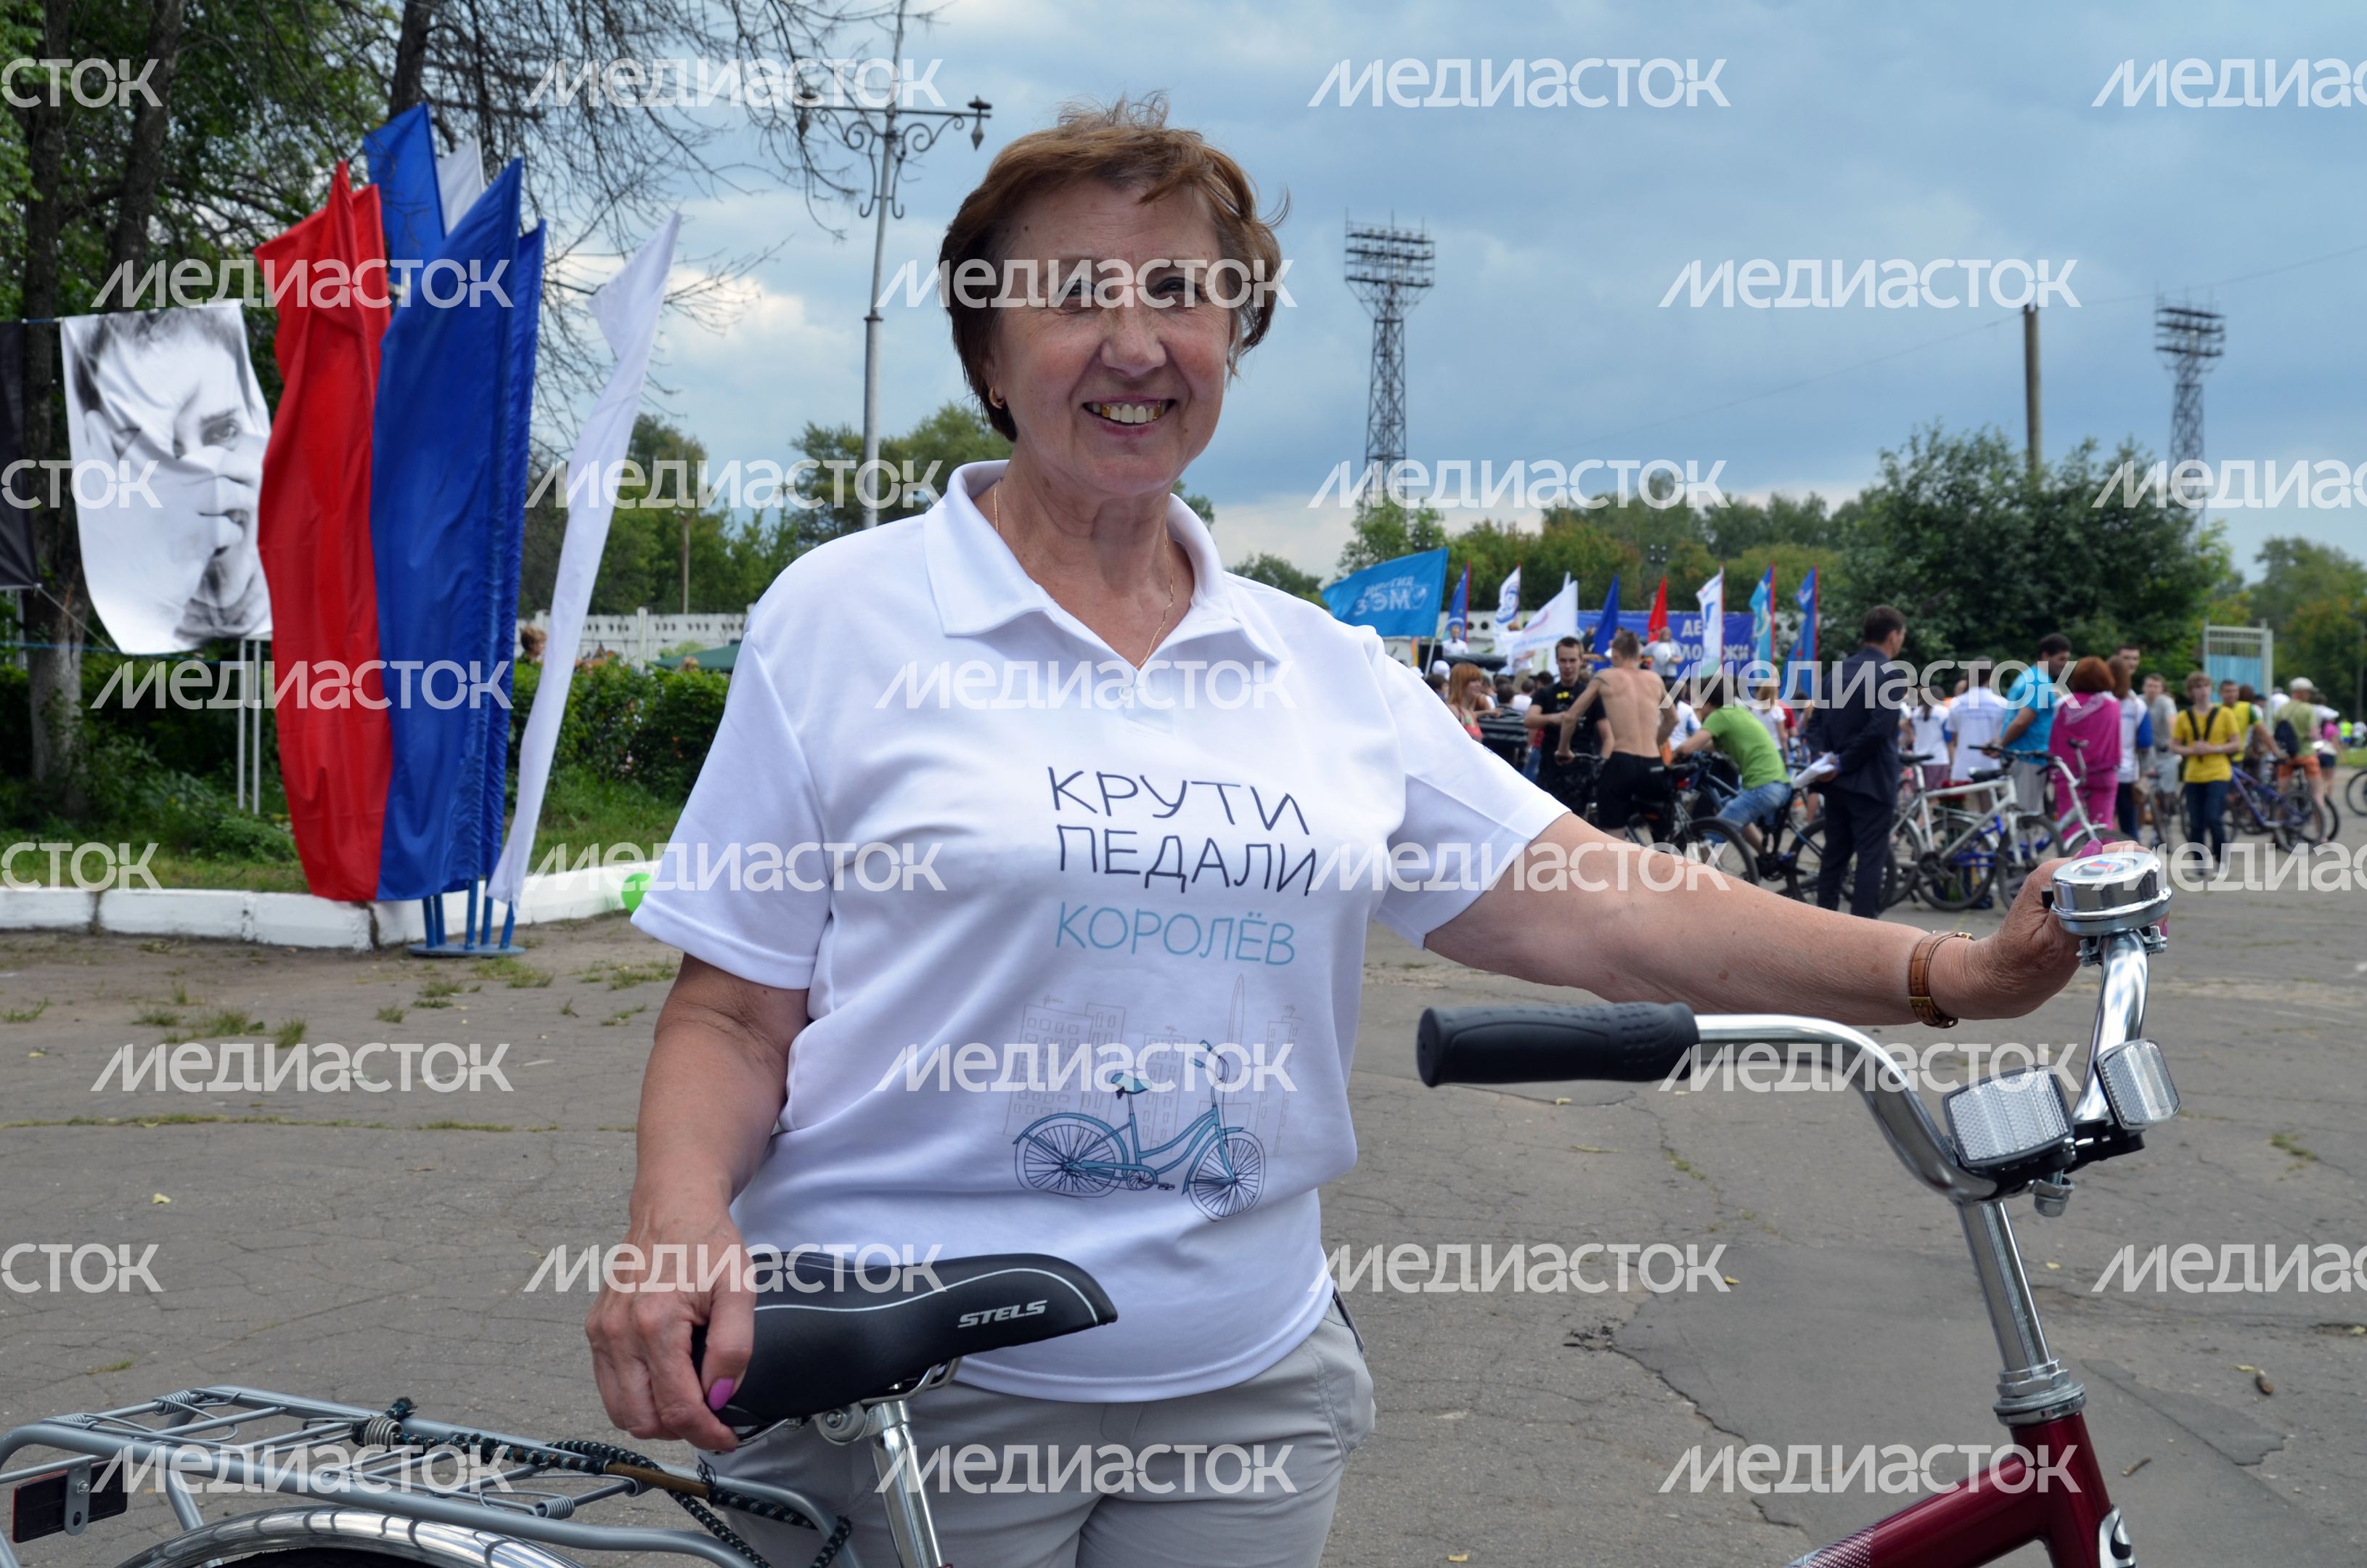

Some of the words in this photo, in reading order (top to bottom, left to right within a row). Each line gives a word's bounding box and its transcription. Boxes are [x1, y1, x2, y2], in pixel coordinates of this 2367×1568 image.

[1047, 765, 1310, 835] КРУТИ
[1055, 824, 1318, 897] ПЕДАЛИ
[1055, 901, 1296, 966] КОРОЛЁВ
[957, 1299, 1048, 1328] STELS
